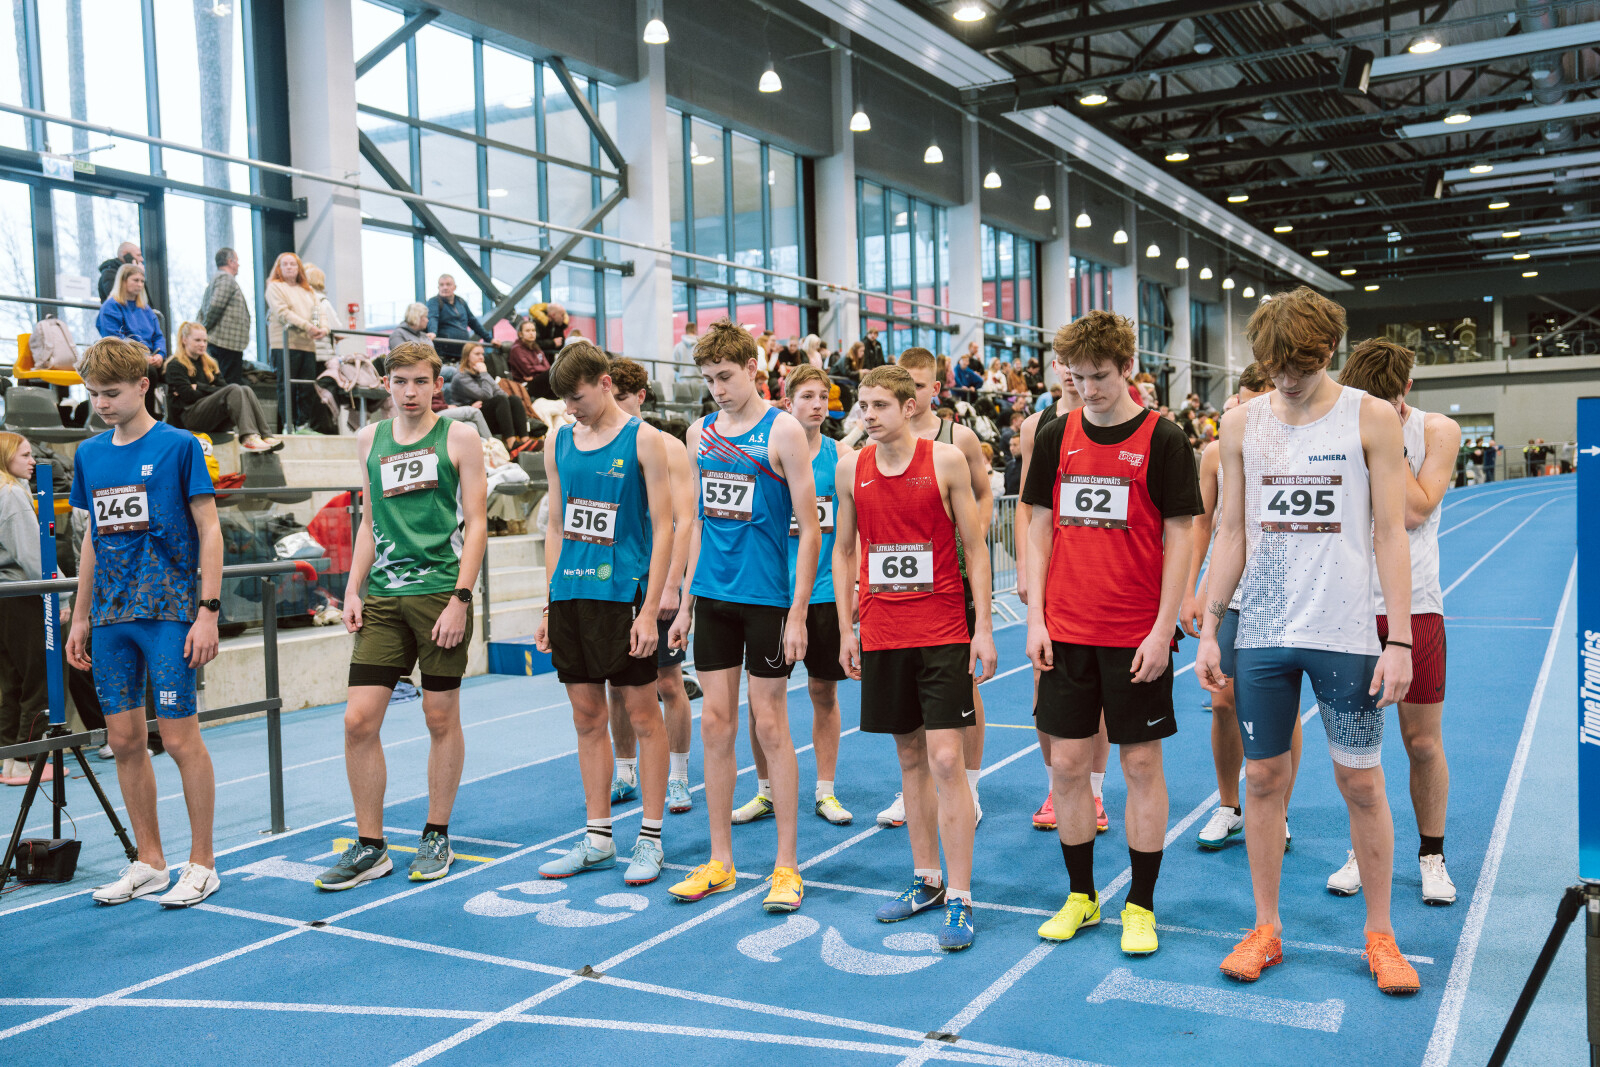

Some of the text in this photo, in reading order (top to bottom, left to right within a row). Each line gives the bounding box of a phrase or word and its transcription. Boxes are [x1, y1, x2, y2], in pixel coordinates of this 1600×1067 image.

[748, 433, 766, 444] A.Š.
[393, 460, 423, 482] 79
[1308, 454, 1346, 464] VALMIERA
[1070, 476, 1121, 485] LATVIJAS ČEMPIONĀTS
[1272, 476, 1332, 484] LATVIJAS ČEMPIONĀTS
[706, 482, 748, 506] 537
[1076, 488, 1112, 513] 62
[1268, 490, 1336, 516] 495
[96, 496, 142, 522] 246
[571, 508, 608, 532] 516
[896, 544, 924, 552] ČEMPIONĀTS
[882, 556, 918, 578] 68
[44, 593, 54, 651] TimeTronic
[463, 879, 649, 928] 3
[736, 914, 945, 976] 2
[1086, 966, 1346, 1034] 1
